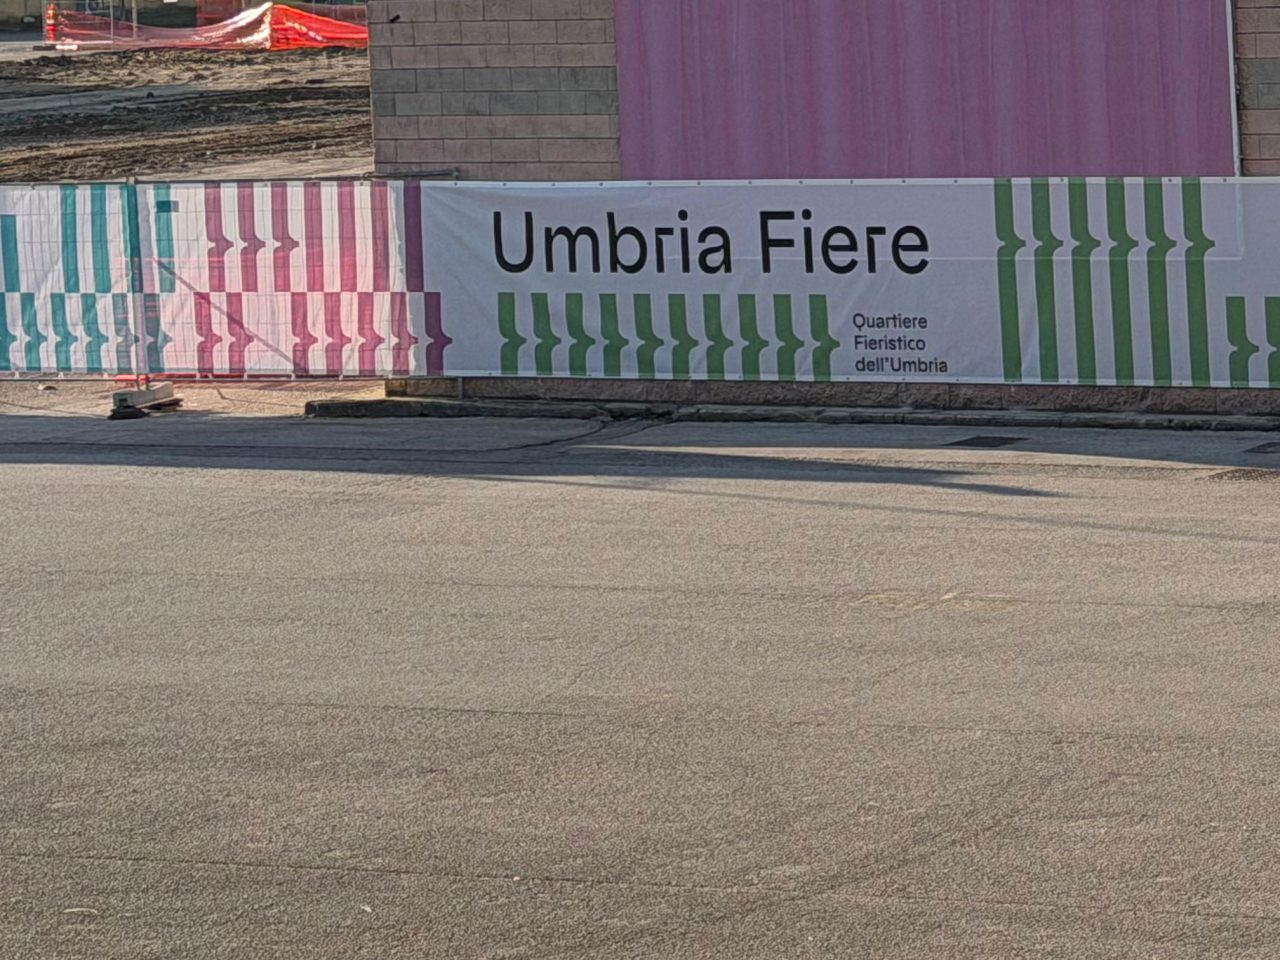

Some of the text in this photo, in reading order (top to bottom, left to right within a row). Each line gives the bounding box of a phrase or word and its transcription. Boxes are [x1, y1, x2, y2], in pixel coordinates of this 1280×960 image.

[493, 208, 930, 275] Umbria Fiere
[852, 313, 928, 331] Quartiere
[854, 334, 926, 351] Fieristico
[855, 357, 948, 373] dell'Umbria
